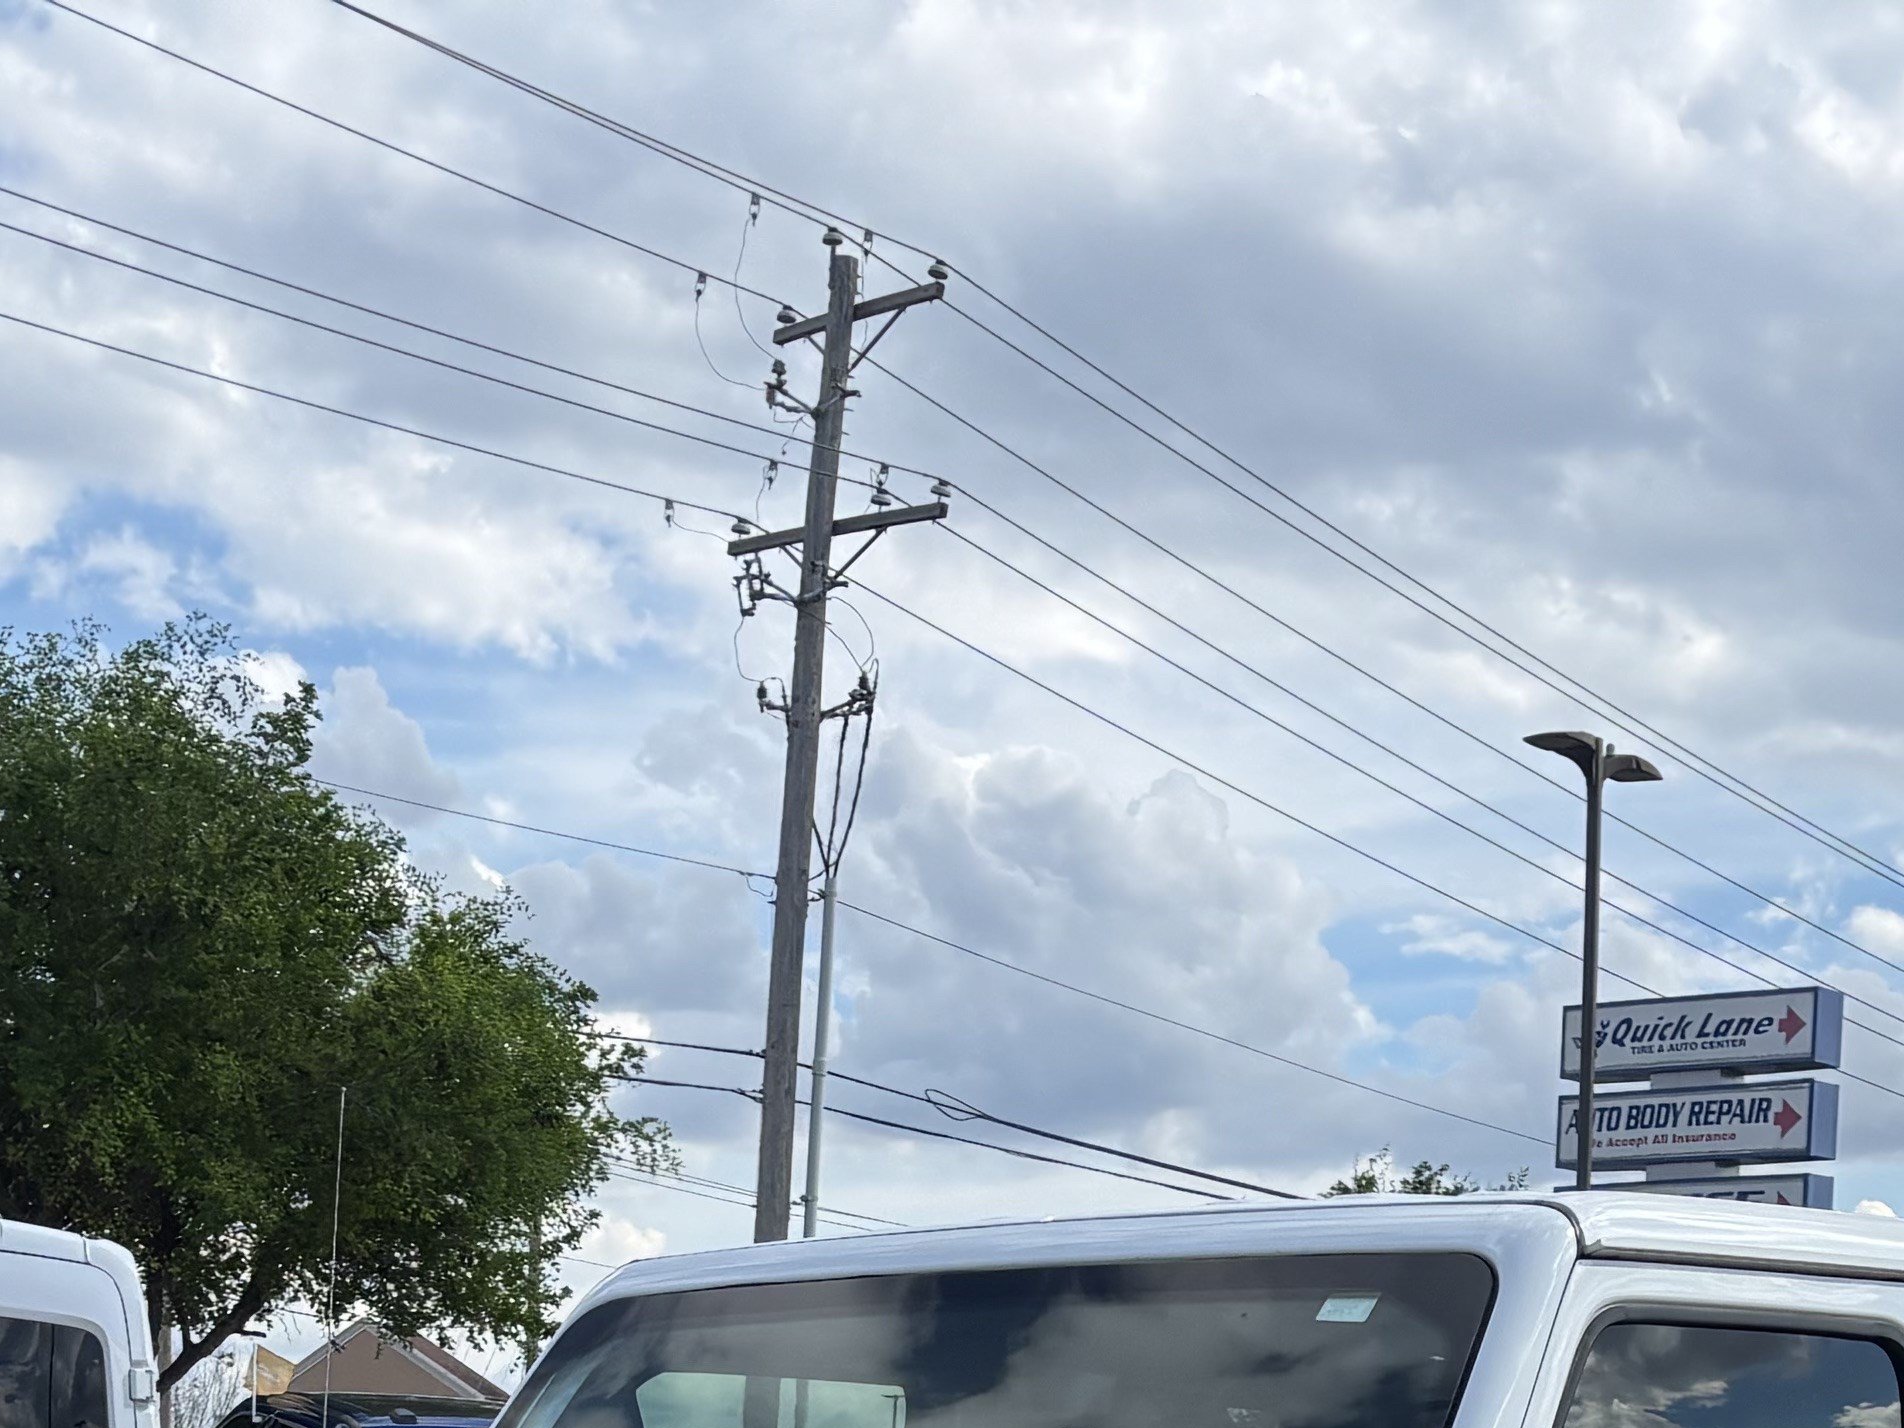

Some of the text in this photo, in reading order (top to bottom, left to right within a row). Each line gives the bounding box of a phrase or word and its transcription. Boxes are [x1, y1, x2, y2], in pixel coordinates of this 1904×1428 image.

[1611, 1012, 1775, 1047] Quick Lane
[1630, 1044, 1655, 1055] TIRE
[1667, 1041, 1698, 1053] AUTO
[1701, 1038, 1747, 1050] CENTER
[1565, 1097, 1773, 1135] ATO BODY REPAIR
[1672, 1132, 1737, 1144] Insurance
